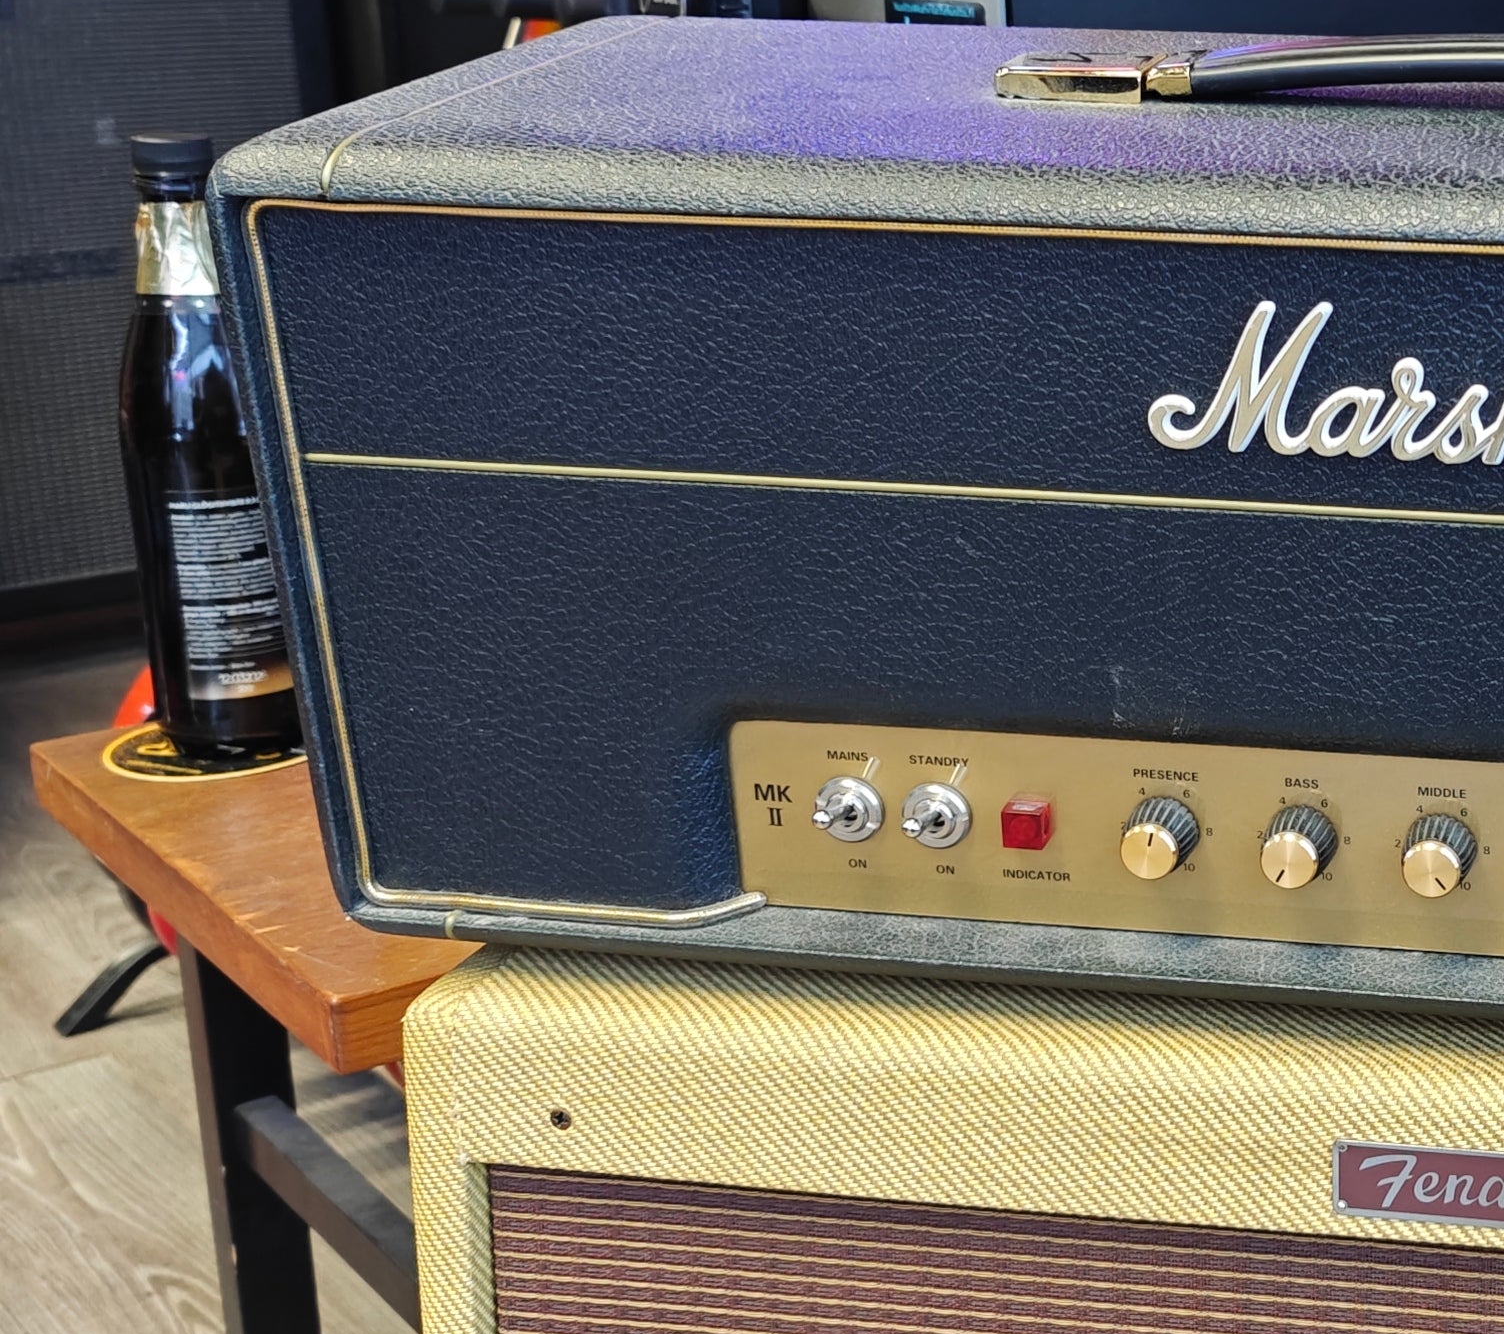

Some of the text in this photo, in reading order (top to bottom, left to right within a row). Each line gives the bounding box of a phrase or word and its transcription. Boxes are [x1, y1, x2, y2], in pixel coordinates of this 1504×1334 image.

[827, 750, 869, 763] MAINS
[908, 754, 969, 768] STANDBY
[1133, 768, 1200, 783] PRESENCE
[1284, 777, 1320, 790] BASS
[754, 783, 793, 804] MK
[1138, 787, 1146, 796] 4
[1183, 789, 1191, 799] 6
[1417, 786, 1467, 799] MIDDLE
[1279, 796, 1287, 805] 4
[1320, 798, 1329, 808] 6
[1416, 805, 1424, 814] 4
[1460, 807, 1469, 817] 6
[768, 807, 785, 827] II
[1205, 827, 1214, 837] 8
[1344, 836, 1352, 846] 8
[1394, 838, 1402, 848] 2
[1482, 845, 1491, 855] 8
[848, 858, 868, 870] ON
[1184, 862, 1196, 872] 10
[936, 864, 956, 876] ON
[1002, 868, 1072, 883] INDICATOR
[1321, 871, 1334, 882] 10
